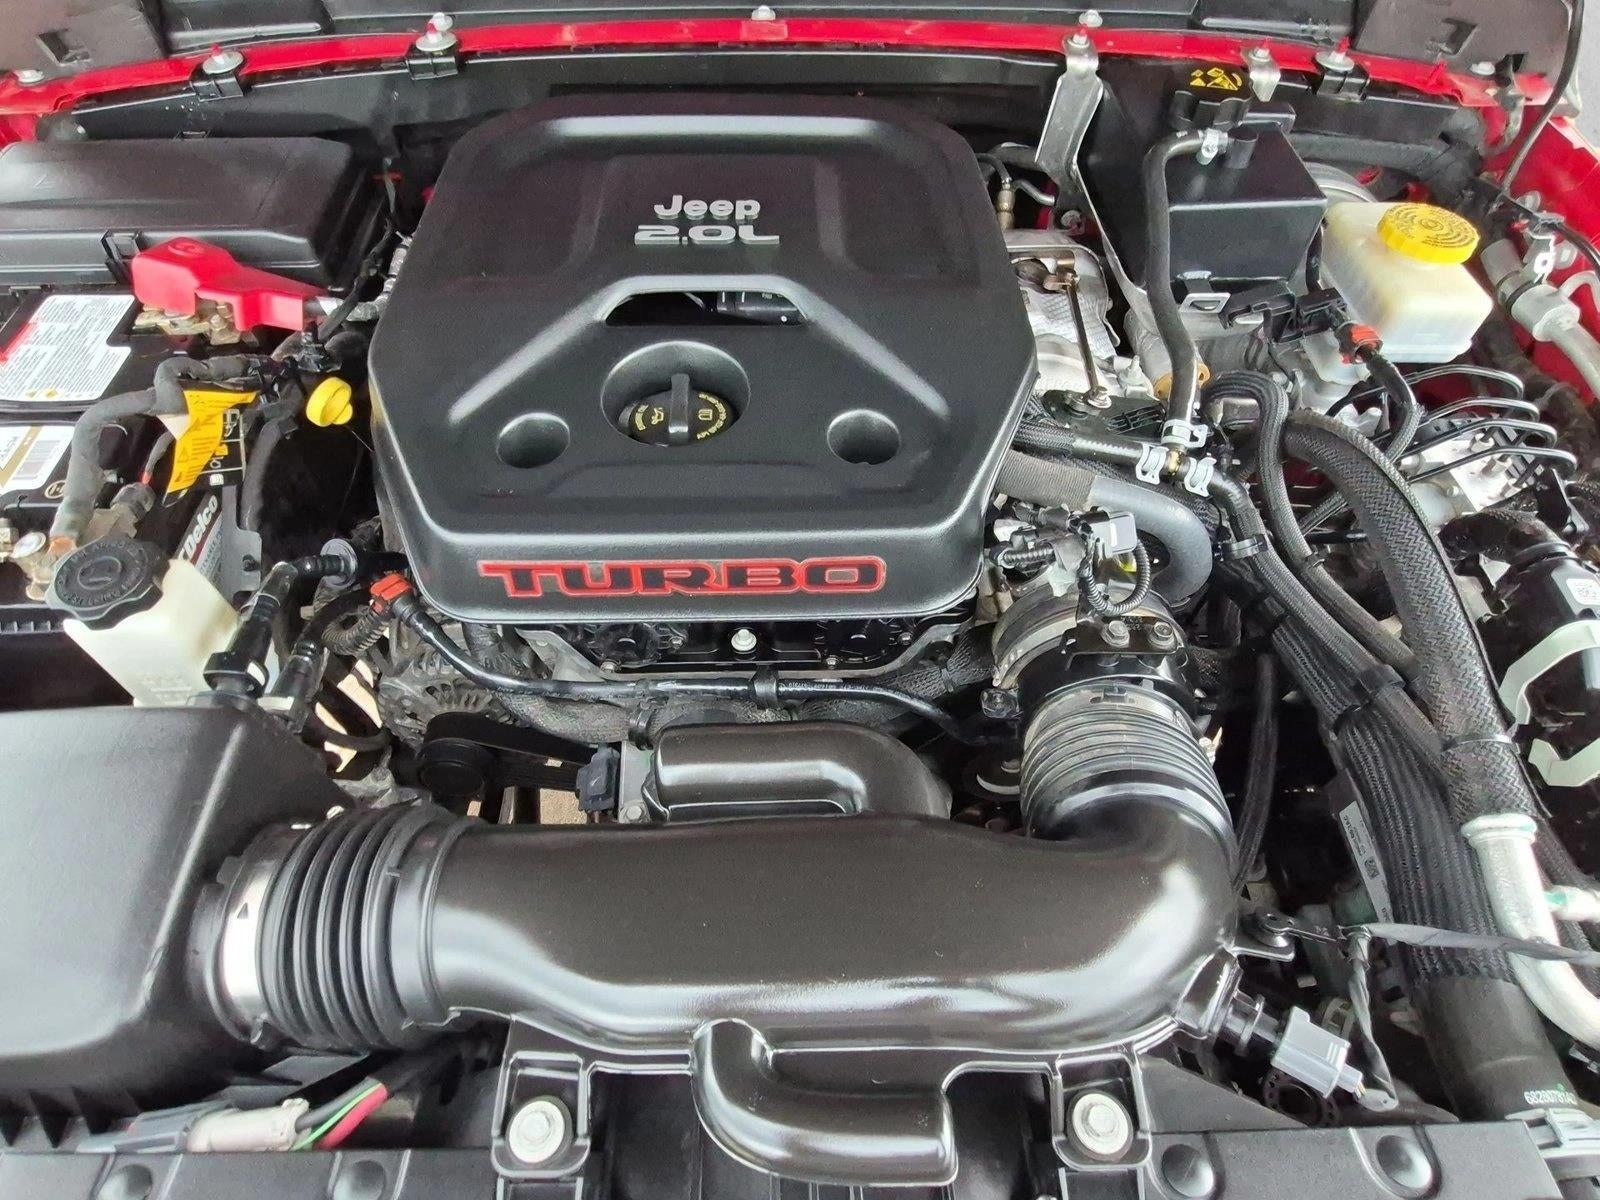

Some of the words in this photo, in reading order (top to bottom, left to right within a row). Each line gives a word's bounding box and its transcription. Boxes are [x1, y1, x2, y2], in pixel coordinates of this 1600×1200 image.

[653, 195, 761, 221] Jeep
[634, 224, 780, 244] 2.0L
[476, 555, 887, 597] TURBO
